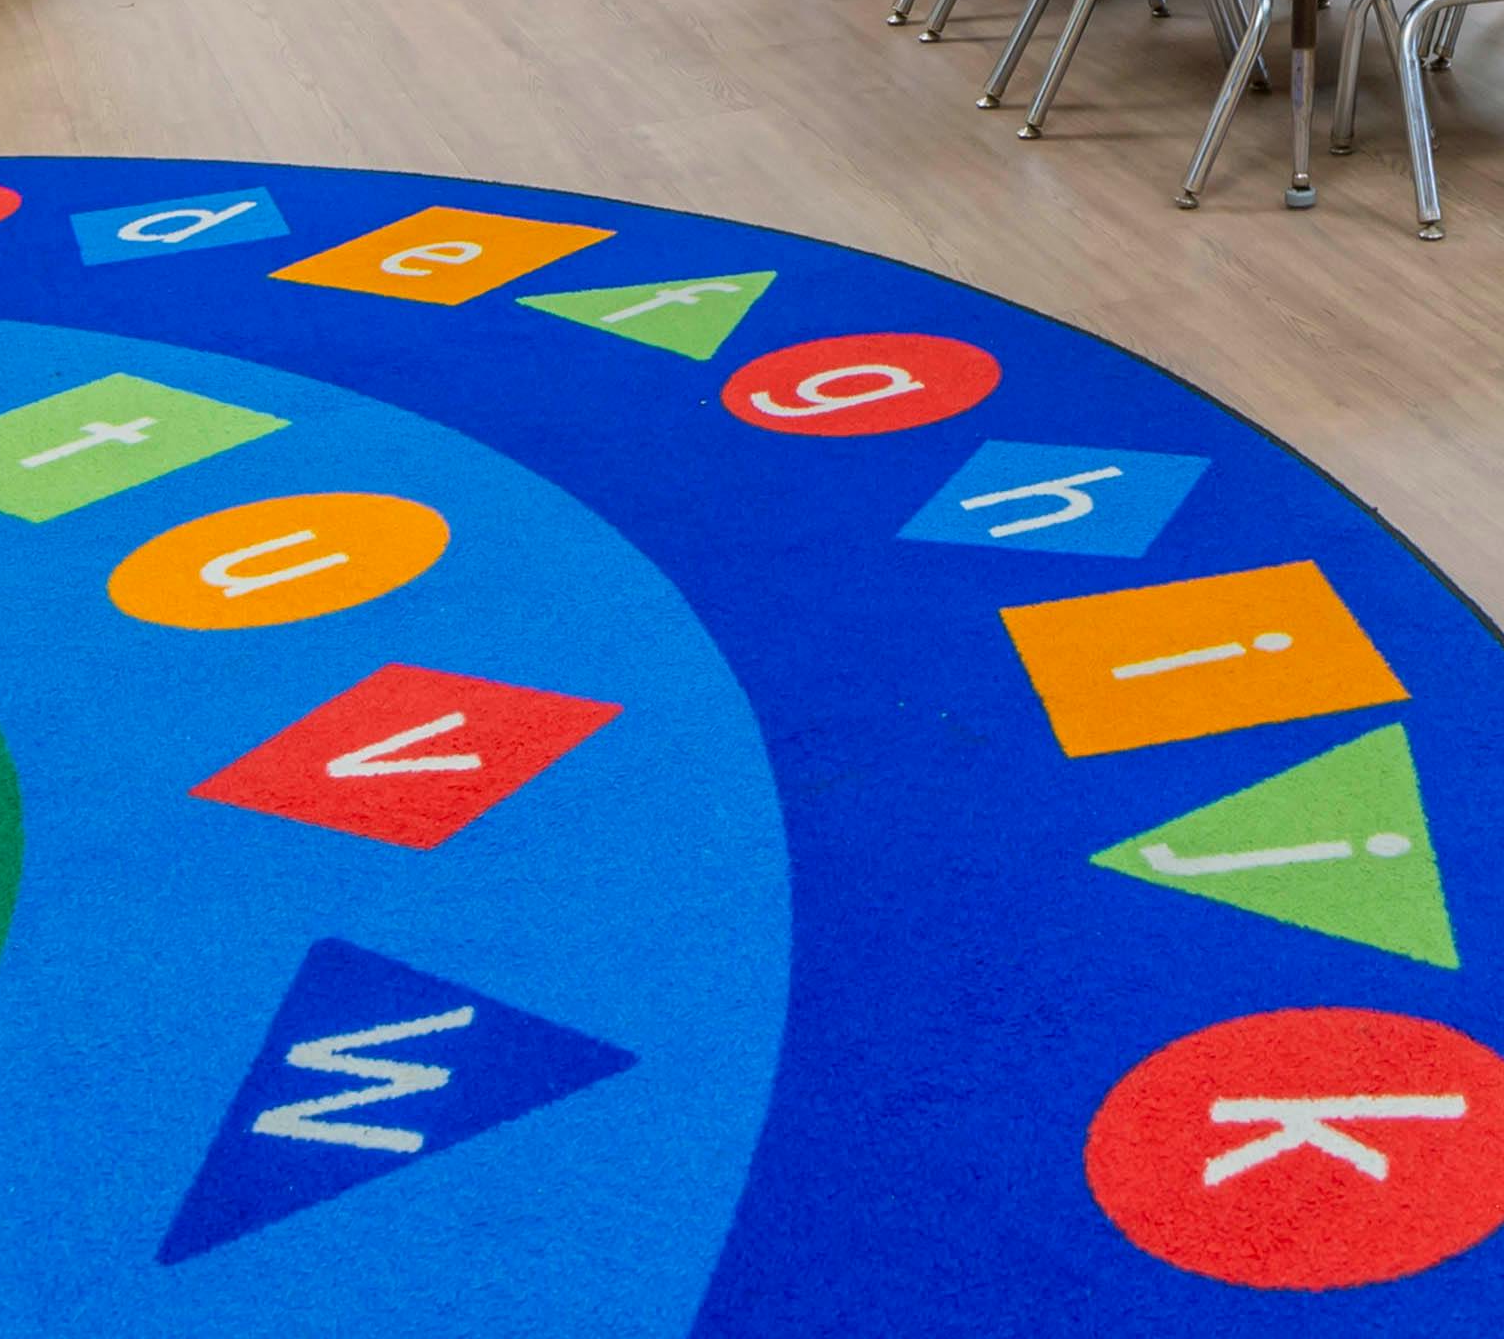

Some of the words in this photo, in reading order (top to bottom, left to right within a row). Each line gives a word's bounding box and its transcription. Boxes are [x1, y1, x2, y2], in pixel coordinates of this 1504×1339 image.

[117, 200, 257, 244] d
[380, 241, 483, 277] e
[598, 281, 742, 326] f
[750, 363, 925, 417] g
[18, 415, 160, 470] t
[960, 465, 1124, 537] h
[199, 530, 348, 598] u
[1112, 632, 1294, 679] i
[325, 712, 483, 779] v
[1138, 831, 1414, 878] j
[252, 1006, 476, 1154] w
[1203, 1094, 1468, 1187] k
